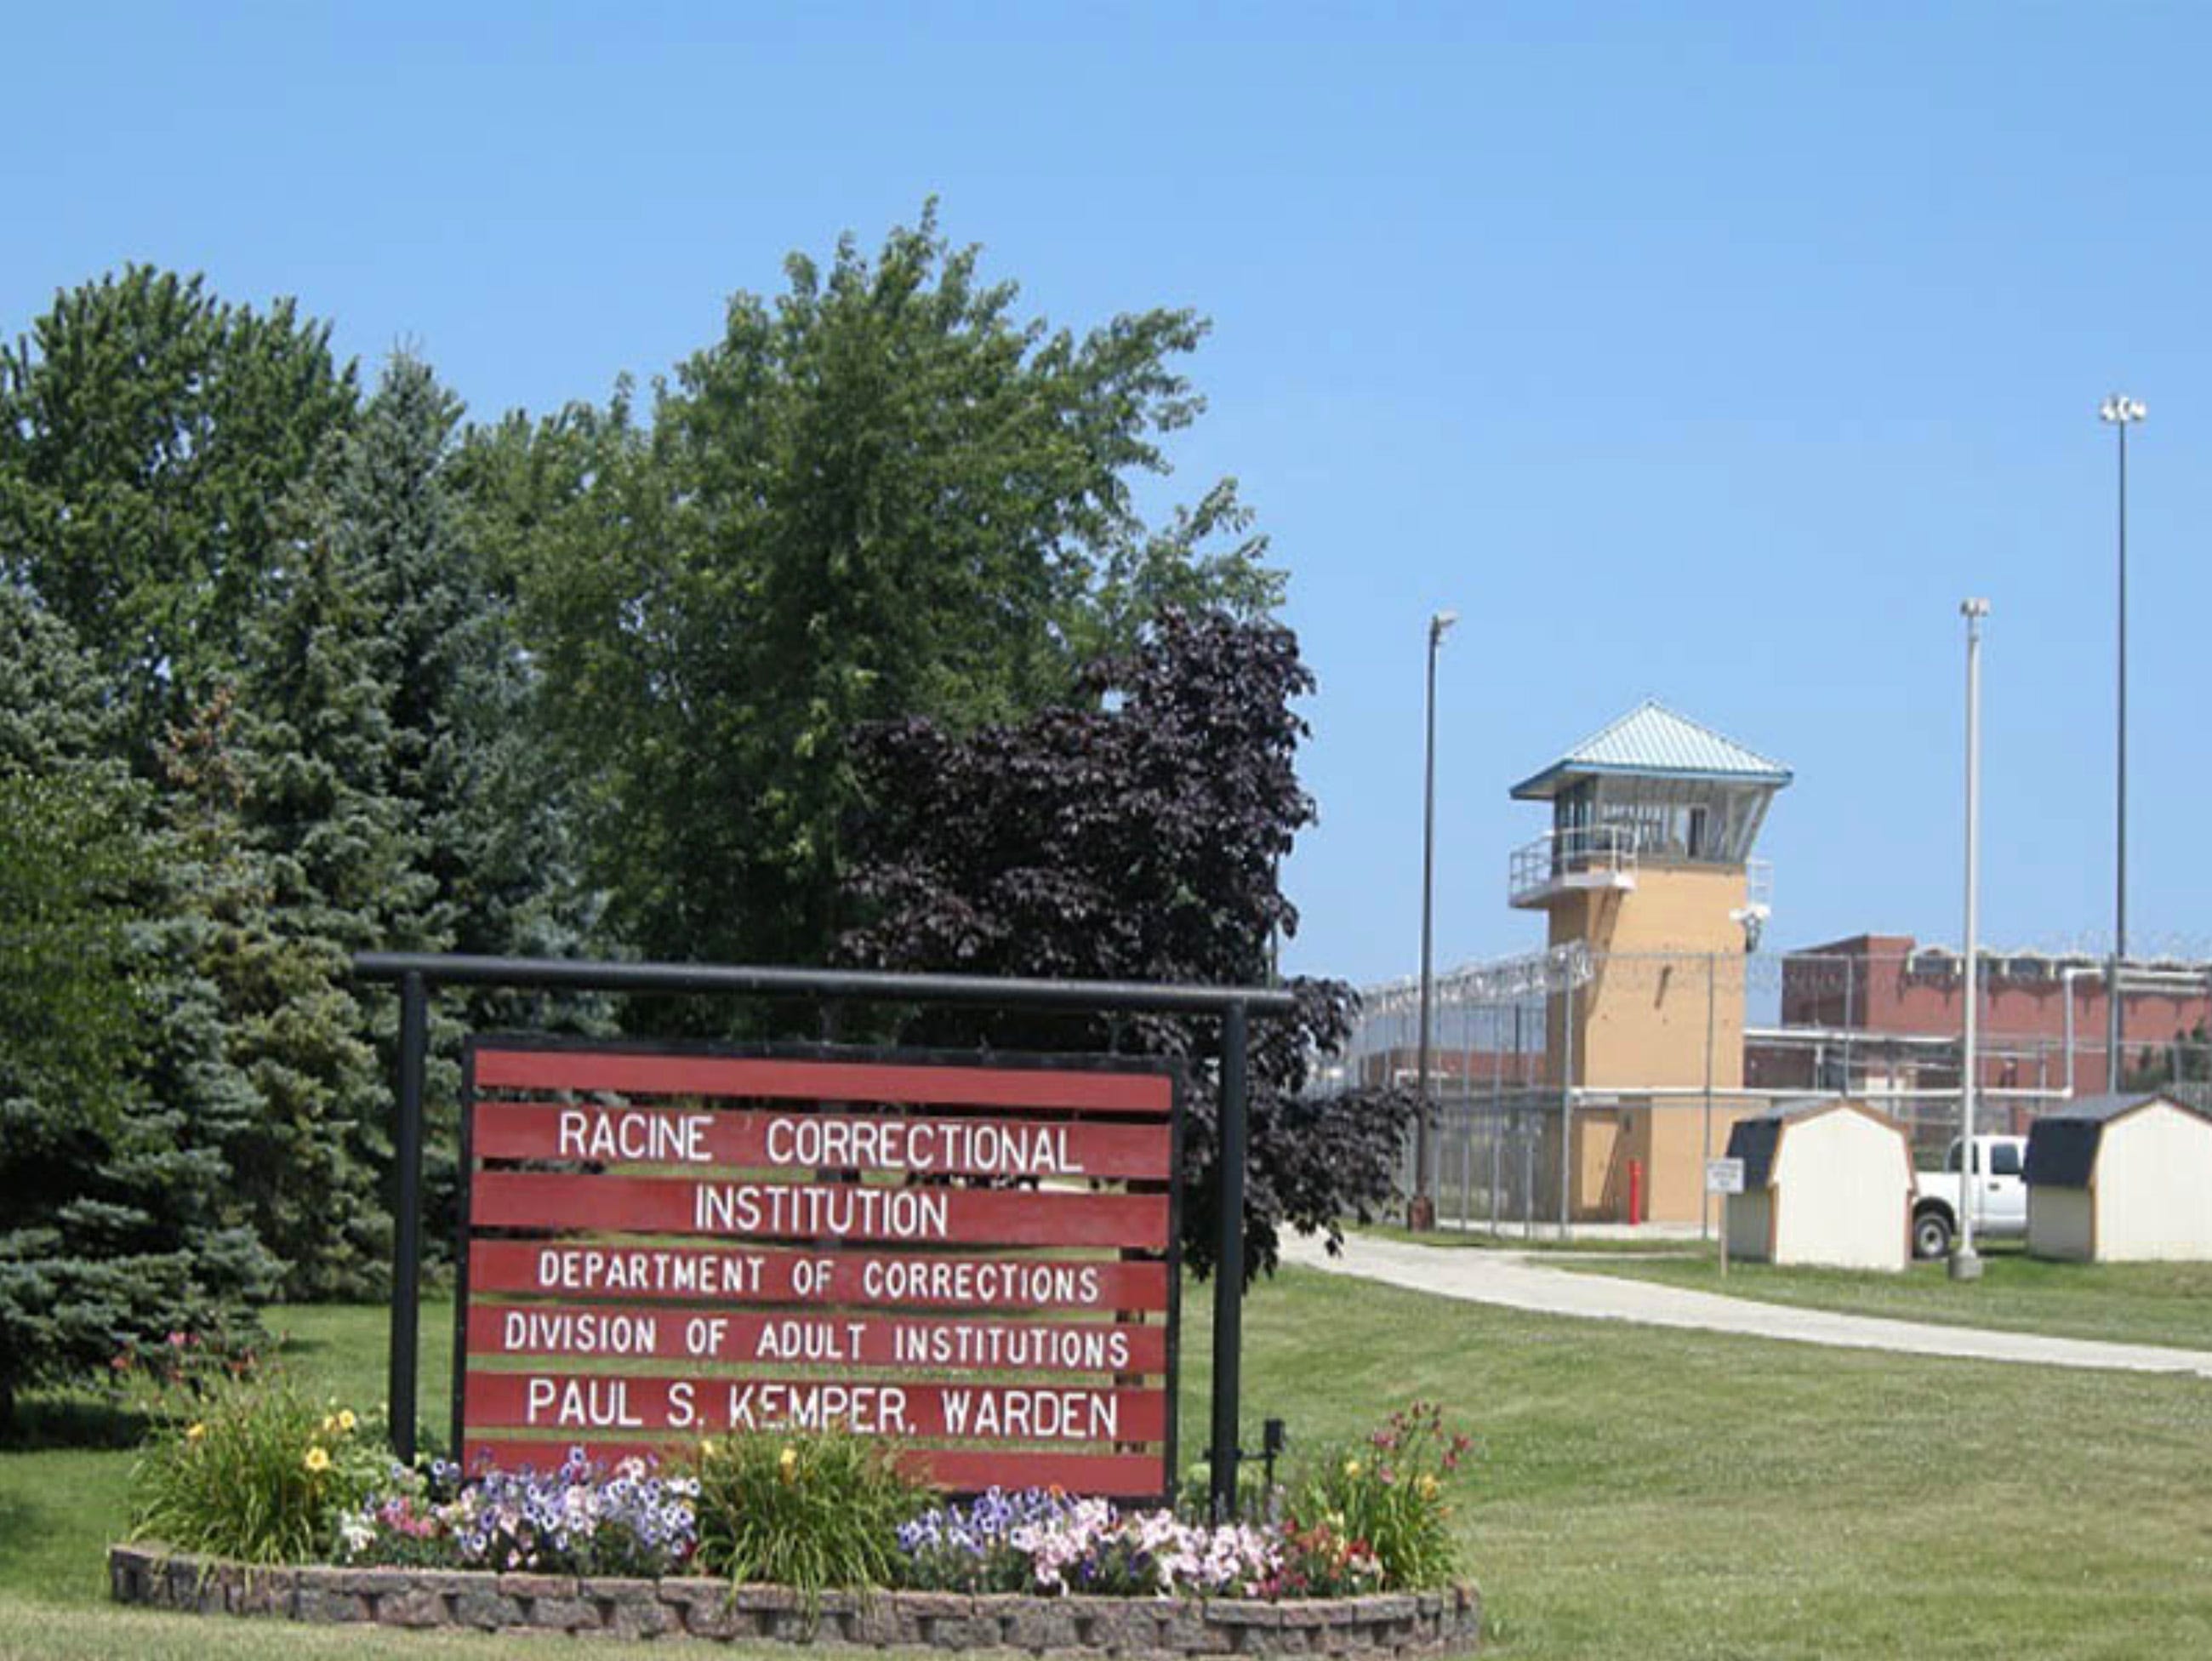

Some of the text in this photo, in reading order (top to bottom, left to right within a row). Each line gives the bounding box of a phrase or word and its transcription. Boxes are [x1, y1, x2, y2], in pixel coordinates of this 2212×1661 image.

[559, 1110, 1084, 1173] RACINE CORRECTIONAL
[695, 1184, 948, 1236] INSTITUTION
[539, 1250, 1099, 1302] DEPARTMENT OF CORRECTIONS
[504, 1311, 1130, 1368] DIVISION OF ADULT INSTITUTIONS
[527, 1378, 642, 1426] PAUL
[667, 1382, 705, 1428] S.
[940, 1389, 1119, 1438] WARDEN
